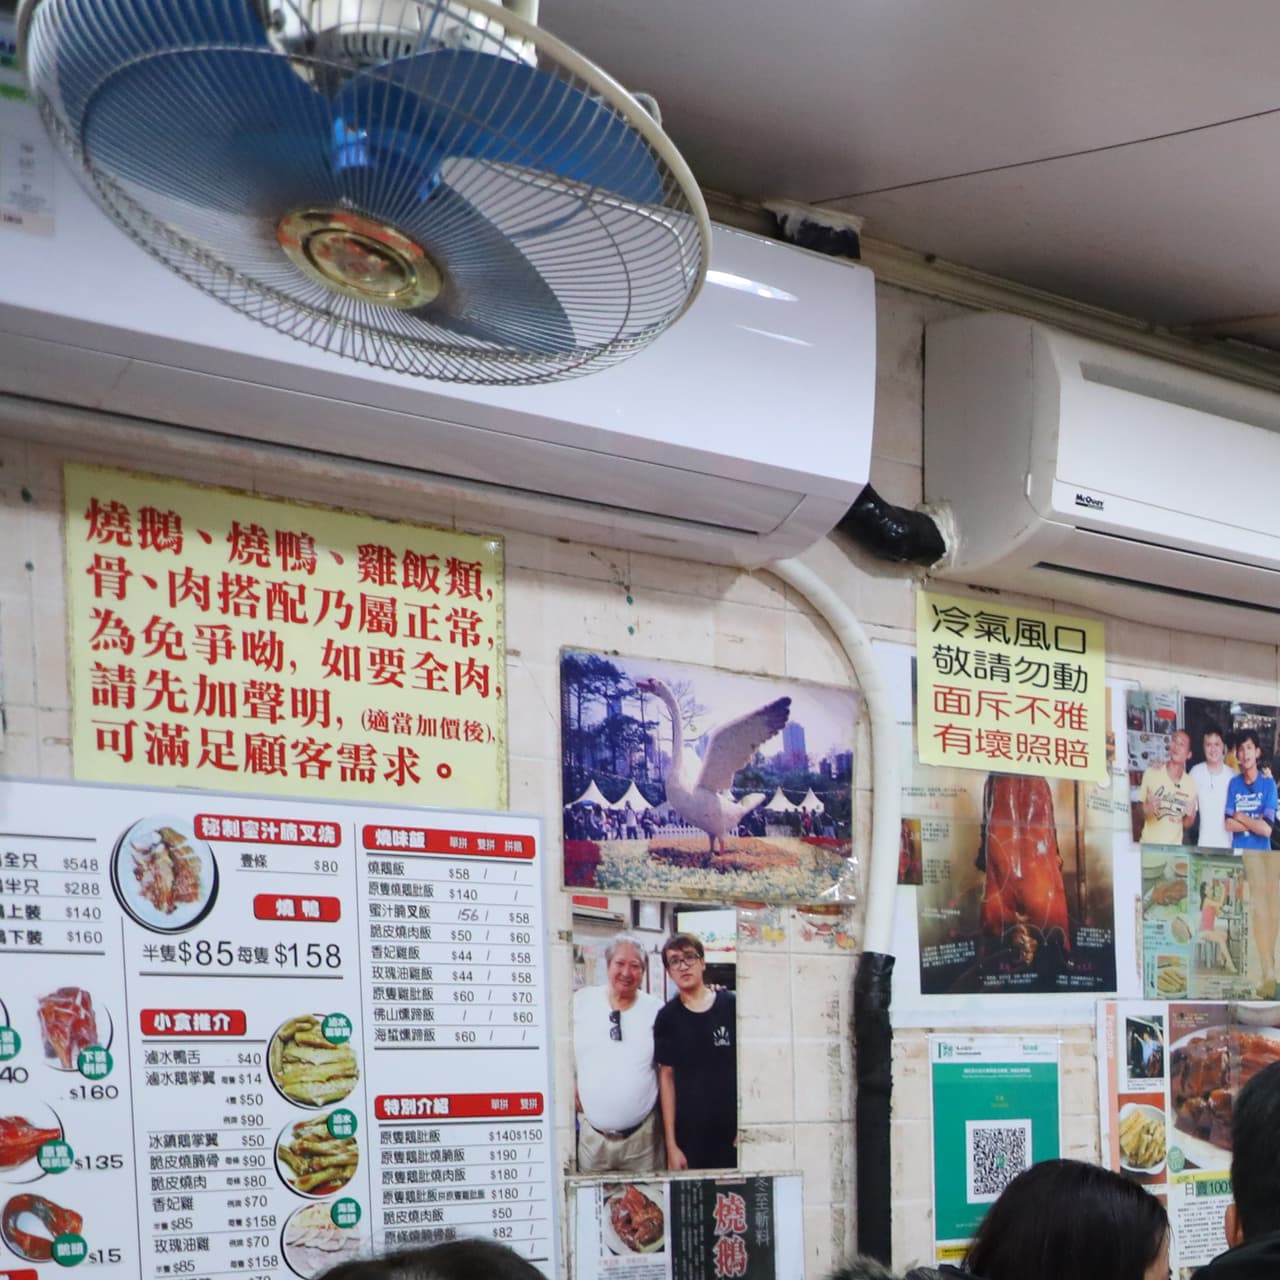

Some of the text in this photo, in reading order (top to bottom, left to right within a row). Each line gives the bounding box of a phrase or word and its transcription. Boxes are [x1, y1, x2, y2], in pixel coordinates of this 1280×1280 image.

[932, 604, 1086, 654] 冷氣風口
[932, 644, 1088, 693] 敬請勿動
[932, 684, 1088, 732] 面斥不雅
[933, 724, 1089, 768] 有壞照賠
[0, 852, 98, 871] 全只 $548
[314, 860, 338, 873] $80
[449, 868, 470, 880] $58
[0, 878, 100, 896] 半只 $288
[449, 889, 478, 901] $140
[65, 907, 101, 920] $140
[509, 913, 529, 924] $58
[67, 931, 102, 944] $160
[451, 930, 472, 942] $50
[510, 932, 531, 944] $60
[275, 942, 342, 969] $158
[451, 950, 472, 961] $44
[511, 952, 531, 964] $58
[452, 971, 473, 982] $44
[512, 972, 532, 983] $58
[453, 991, 533, 1003] $60 $70
[513, 1012, 533, 1024] $60
[455, 1031, 476, 1042] $60
[238, 1053, 261, 1064] $40
[239, 1073, 262, 1084] $14
[70, 1085, 119, 1099] $160
[240, 1094, 264, 1105] $50
[241, 1115, 264, 1126] $90
[241, 1135, 264, 1146] $50
[489, 1129, 543, 1142] $140 $150
[74, 1154, 124, 1169] $135
[242, 1155, 265, 1166] $90
[490, 1150, 517, 1161] $190
[491, 1169, 518, 1180] $180
[244, 1176, 266, 1187] $80
[491, 1188, 519, 1200] $180
[244, 1196, 267, 1207] $70
[492, 1207, 512, 1219] $50
[171, 1218, 193, 1230] $85
[245, 1216, 276, 1227] $158
[492, 1227, 513, 1238] $82
[713, 1191, 748, 1277] 燒鵝
[246, 1236, 270, 1247] $70
[88, 1248, 122, 1265] $15
[173, 1261, 195, 1272] $85
[247, 1256, 279, 1268] $158
